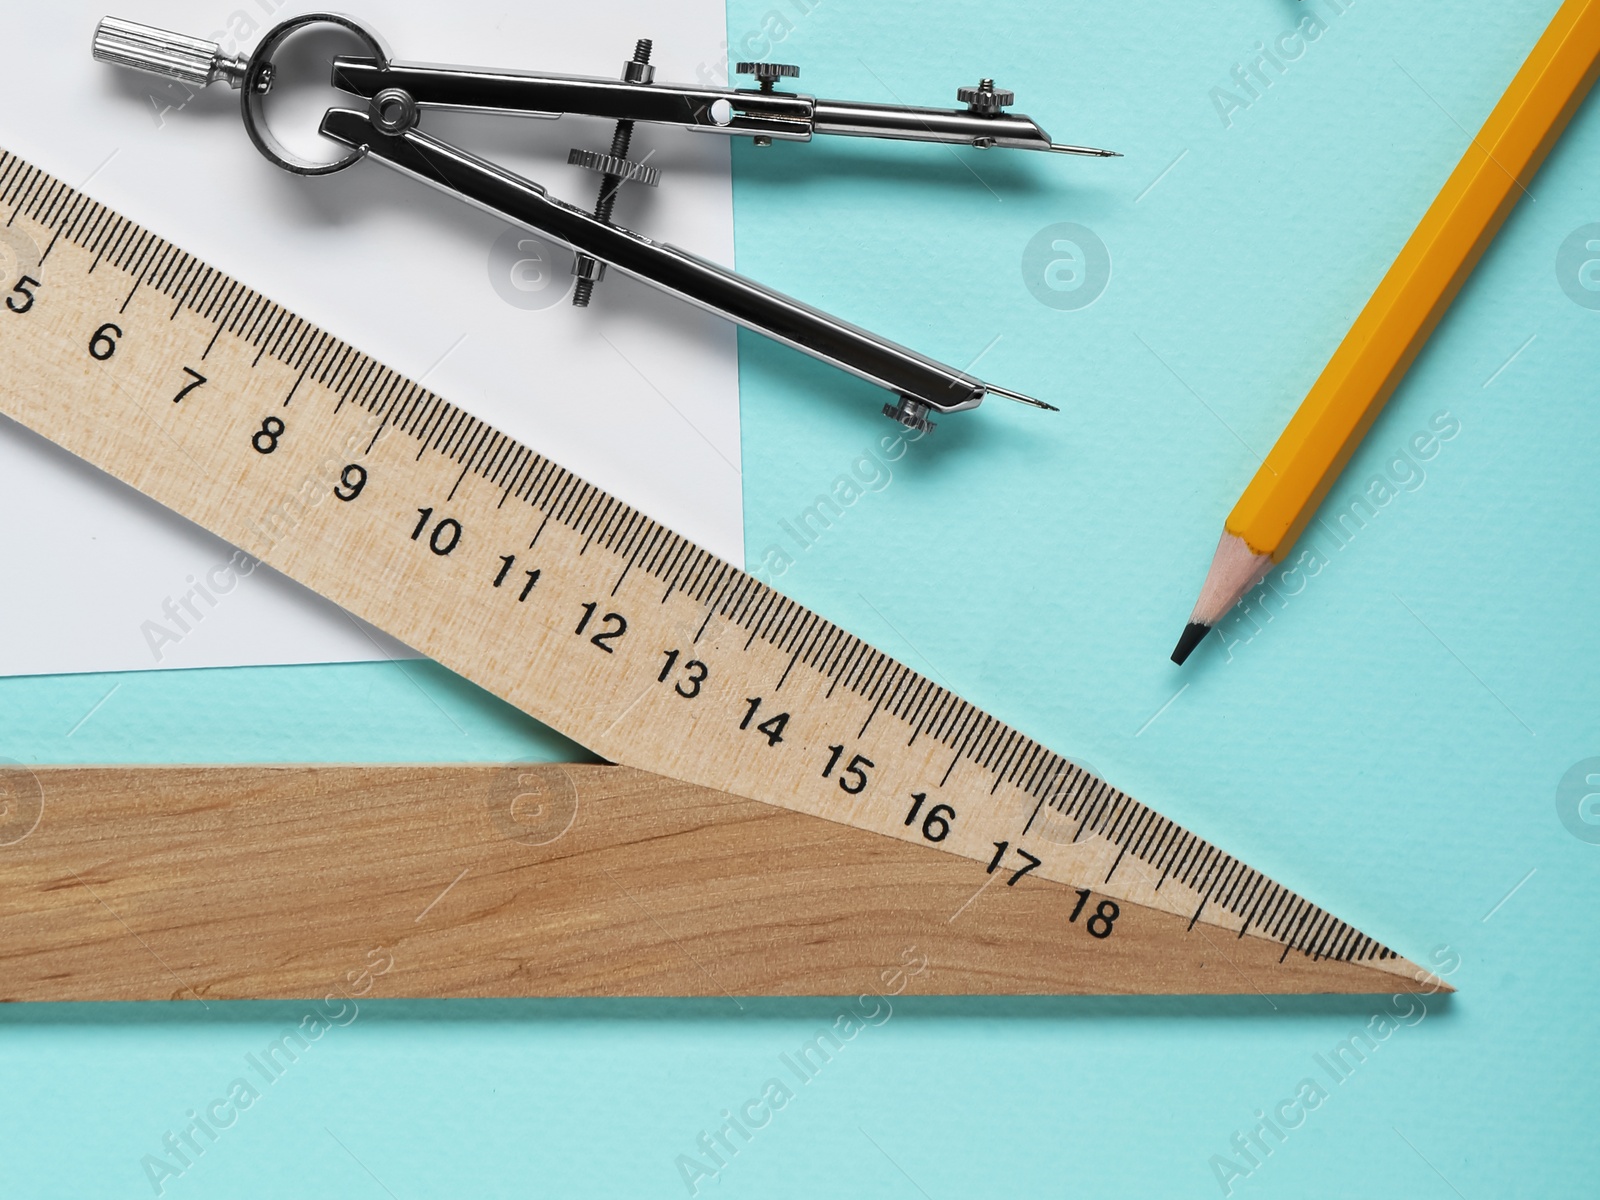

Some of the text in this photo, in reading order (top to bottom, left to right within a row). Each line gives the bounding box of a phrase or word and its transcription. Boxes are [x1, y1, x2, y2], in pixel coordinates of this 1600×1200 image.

[6, 276, 1119, 939] 5 6 7 8 9 10 11 12 13 14 15 16 17 18
